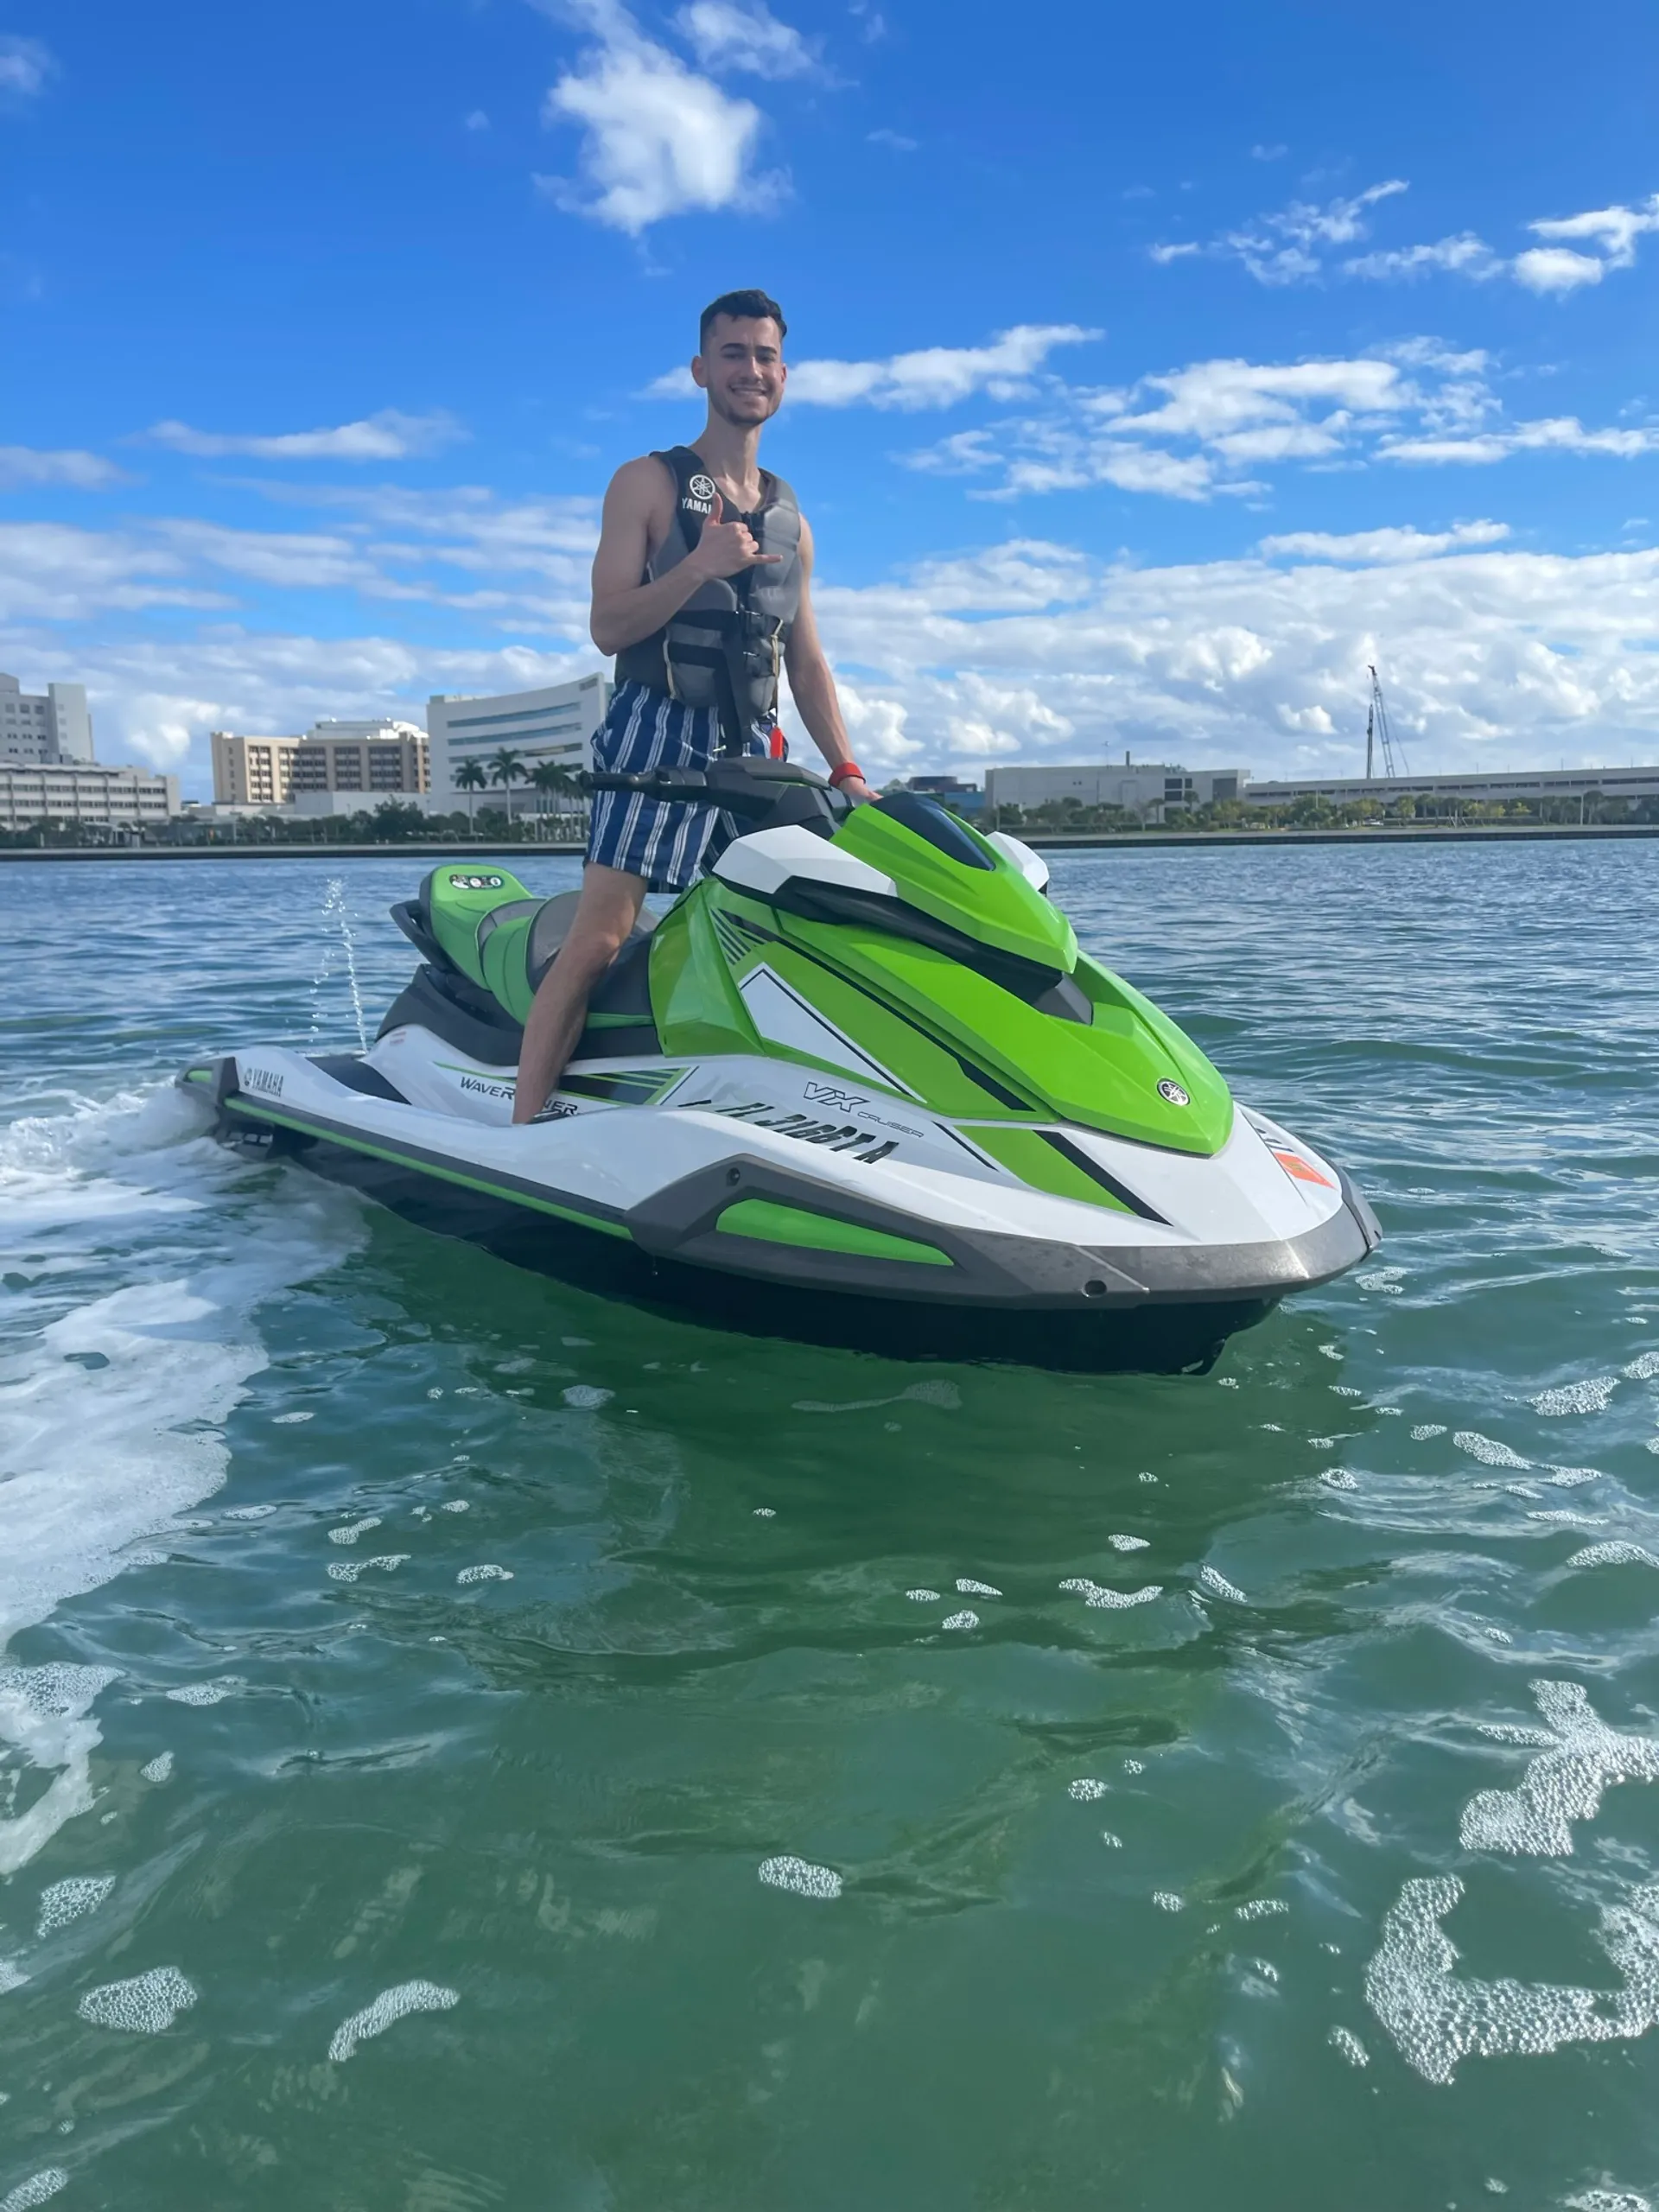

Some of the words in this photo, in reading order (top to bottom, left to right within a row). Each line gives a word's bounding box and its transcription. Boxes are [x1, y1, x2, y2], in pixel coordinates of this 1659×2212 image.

[681, 497, 712, 516] YAMA
[251, 1068, 284, 1097] YAMAHA
[803, 1081, 871, 1113] VX
[857, 1111, 925, 1139] CRUISER
